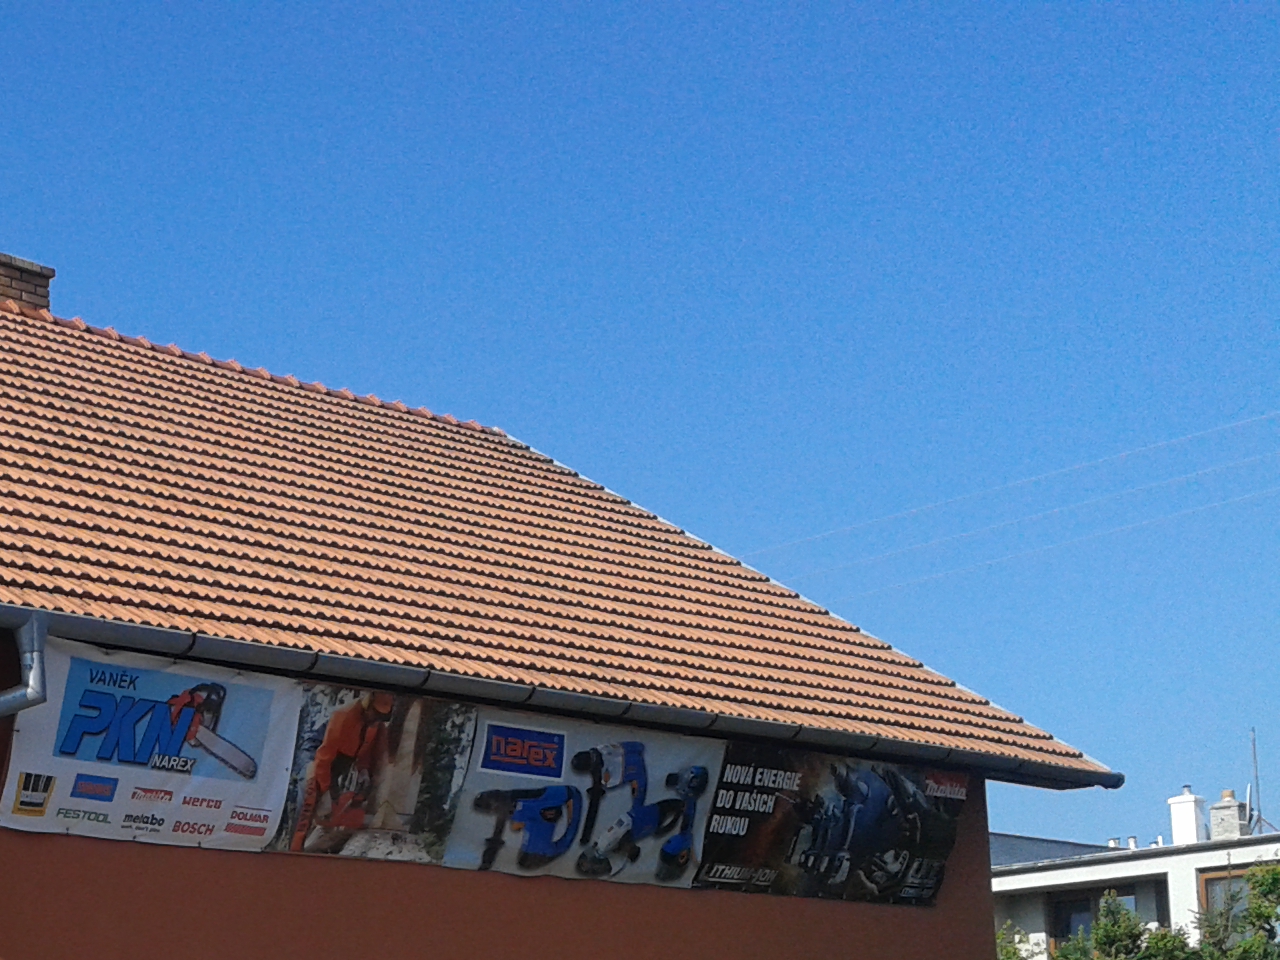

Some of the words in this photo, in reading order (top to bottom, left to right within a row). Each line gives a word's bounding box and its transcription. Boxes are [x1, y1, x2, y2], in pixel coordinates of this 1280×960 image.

[89, 668, 140, 691] VANĚK
[59, 689, 196, 765] PKN
[491, 735, 559, 768] narex
[151, 754, 196, 773] NAREX
[723, 763, 755, 785] NOVÁ
[754, 768, 803, 791] ENERGIE
[716, 789, 735, 809] DO
[734, 789, 777, 813] VAŠICH
[56, 807, 112, 824] FESTOOL
[122, 813, 166, 827] metabo
[709, 814, 750, 836] RUKOU
[172, 820, 216, 836] BOSCH
